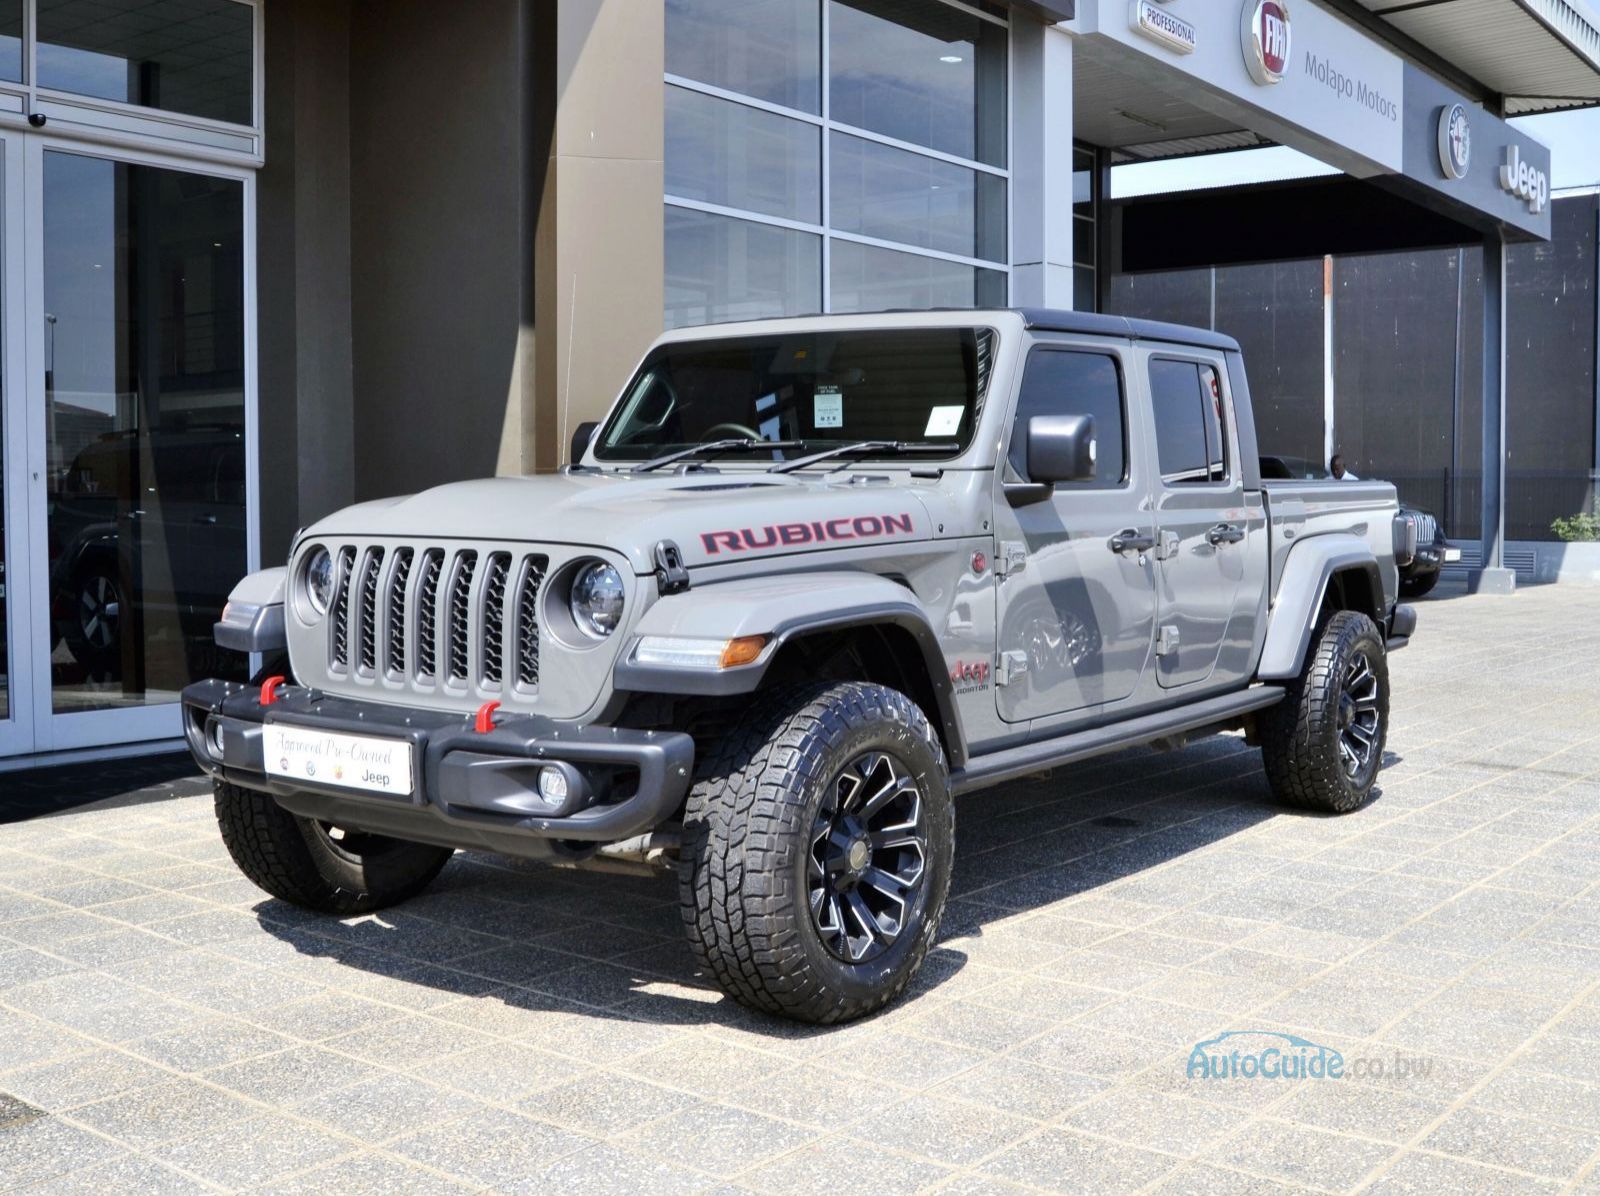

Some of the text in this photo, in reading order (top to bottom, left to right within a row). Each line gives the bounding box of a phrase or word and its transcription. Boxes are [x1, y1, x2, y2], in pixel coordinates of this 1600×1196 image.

[1147, 7, 1196, 45] PROFESSIONAL
[1304, 50, 1353, 99] Molapo
[1356, 80, 1397, 122] Motors
[1503, 144, 1547, 213] Jeep
[699, 512, 914, 555] RUBICON
[950, 658, 990, 686] Jeep
[275, 731, 393, 767] Approved Pre-Owned
[361, 768, 391, 788] Jeep
